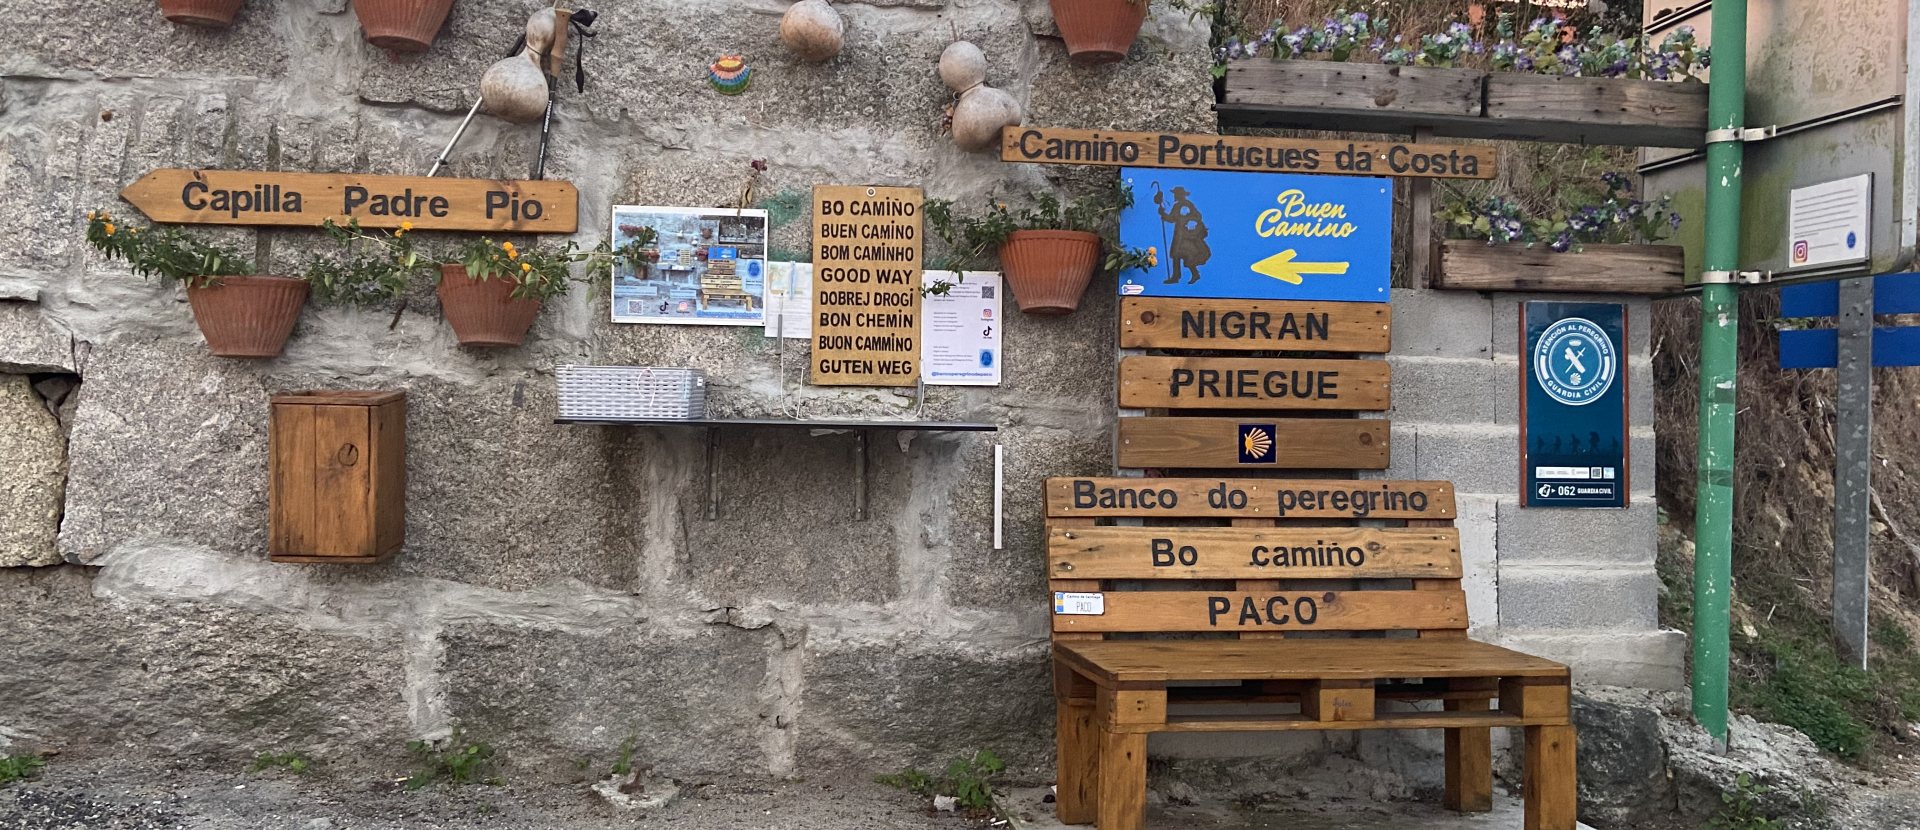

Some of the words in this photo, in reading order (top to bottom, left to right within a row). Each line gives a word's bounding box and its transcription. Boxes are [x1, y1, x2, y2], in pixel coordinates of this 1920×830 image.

[1020, 130, 1139, 163] Camiño
[1157, 134, 1320, 170] Portugues
[1335, 144, 1372, 172] da
[1388, 146, 1479, 176] Costa
[181, 181, 303, 219] Capilla
[343, 185, 449, 218] Padre
[485, 190, 544, 221] Pio
[822, 200, 845, 216] BO
[1277, 189, 1348, 220] Buen
[821, 223, 857, 239] BUEN
[861, 220, 914, 240] CAMINO
[1255, 208, 1358, 239] Camino
[821, 245, 850, 261] BOM
[853, 242, 914, 262] CAMINHO
[821, 267, 870, 283] GOOD
[876, 269, 913, 285] WAY
[820, 291, 870, 307] DOBREJ
[873, 288, 914, 307] DROGI
[820, 312, 851, 327] BON
[856, 309, 913, 328] CHEMIN
[1181, 310, 1329, 341] NIGRAN
[819, 335, 852, 350] BUON
[855, 333, 913, 352] CAMMINO
[1541, 325, 1566, 354] ATENCIÓN
[1578, 325, 1609, 355] PEREGRINO
[819, 359, 873, 375] GUTEN
[877, 360, 912, 375] WEG
[1170, 368, 1339, 400] PRIEGUE
[1547, 380, 1581, 398] GUARDIA
[1584, 381, 1603, 396] CIVIL
[1072, 479, 1179, 510] Banco
[1207, 482, 1248, 510] do
[1277, 484, 1429, 517] peregrino
[1558, 485, 1576, 496] 062
[1151, 538, 1198, 567] Bo
[1208, 595, 1318, 626] PACO
